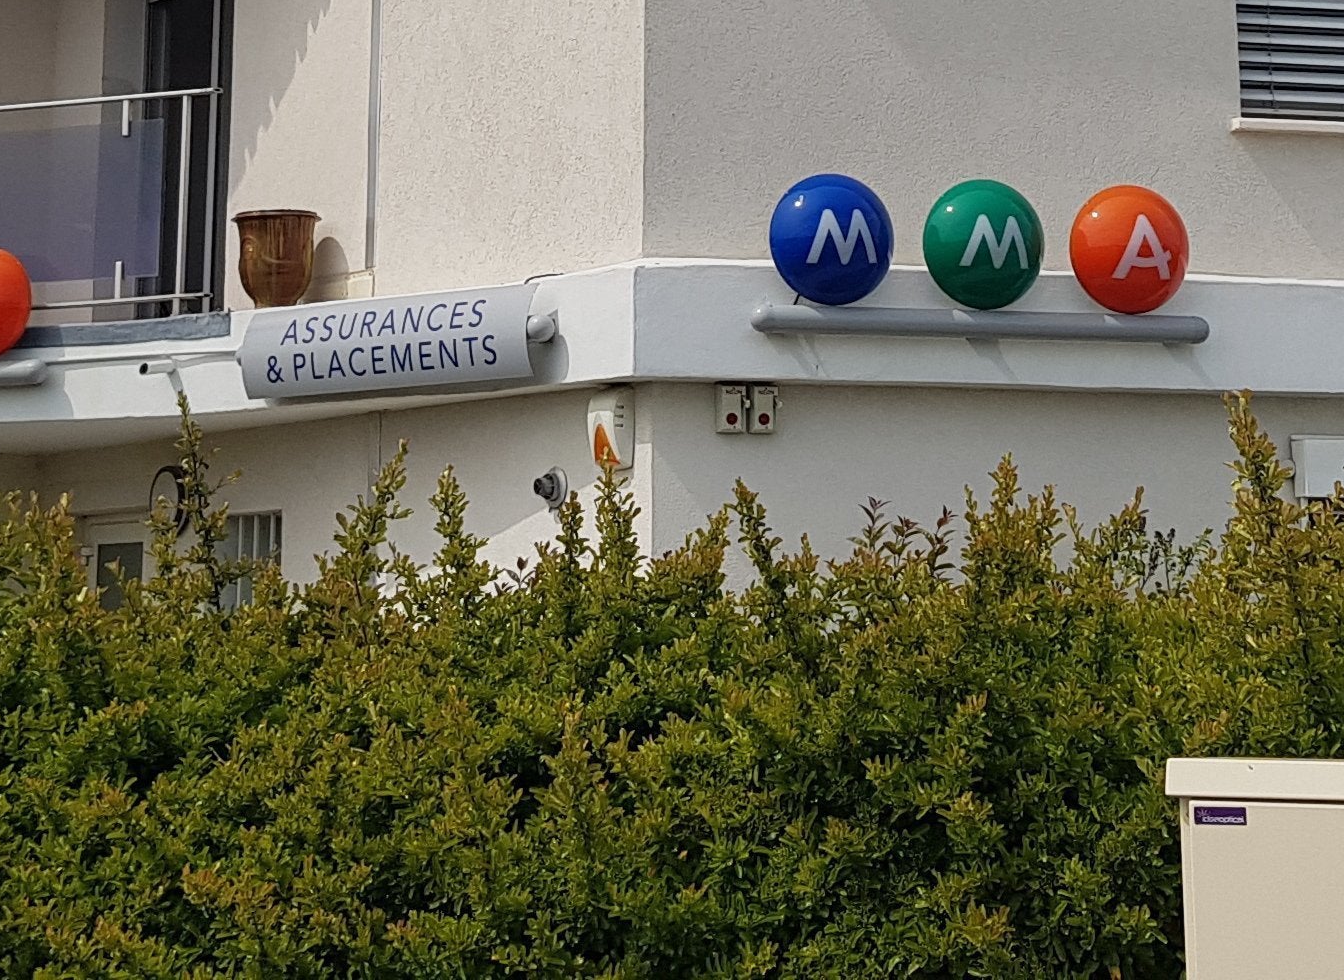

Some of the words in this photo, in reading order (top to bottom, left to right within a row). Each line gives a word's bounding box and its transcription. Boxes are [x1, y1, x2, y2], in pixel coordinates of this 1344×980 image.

[280, 299, 487, 346] ASSURANCES
[266, 355, 285, 384] &
[293, 335, 498, 381] PLACEMENTS
